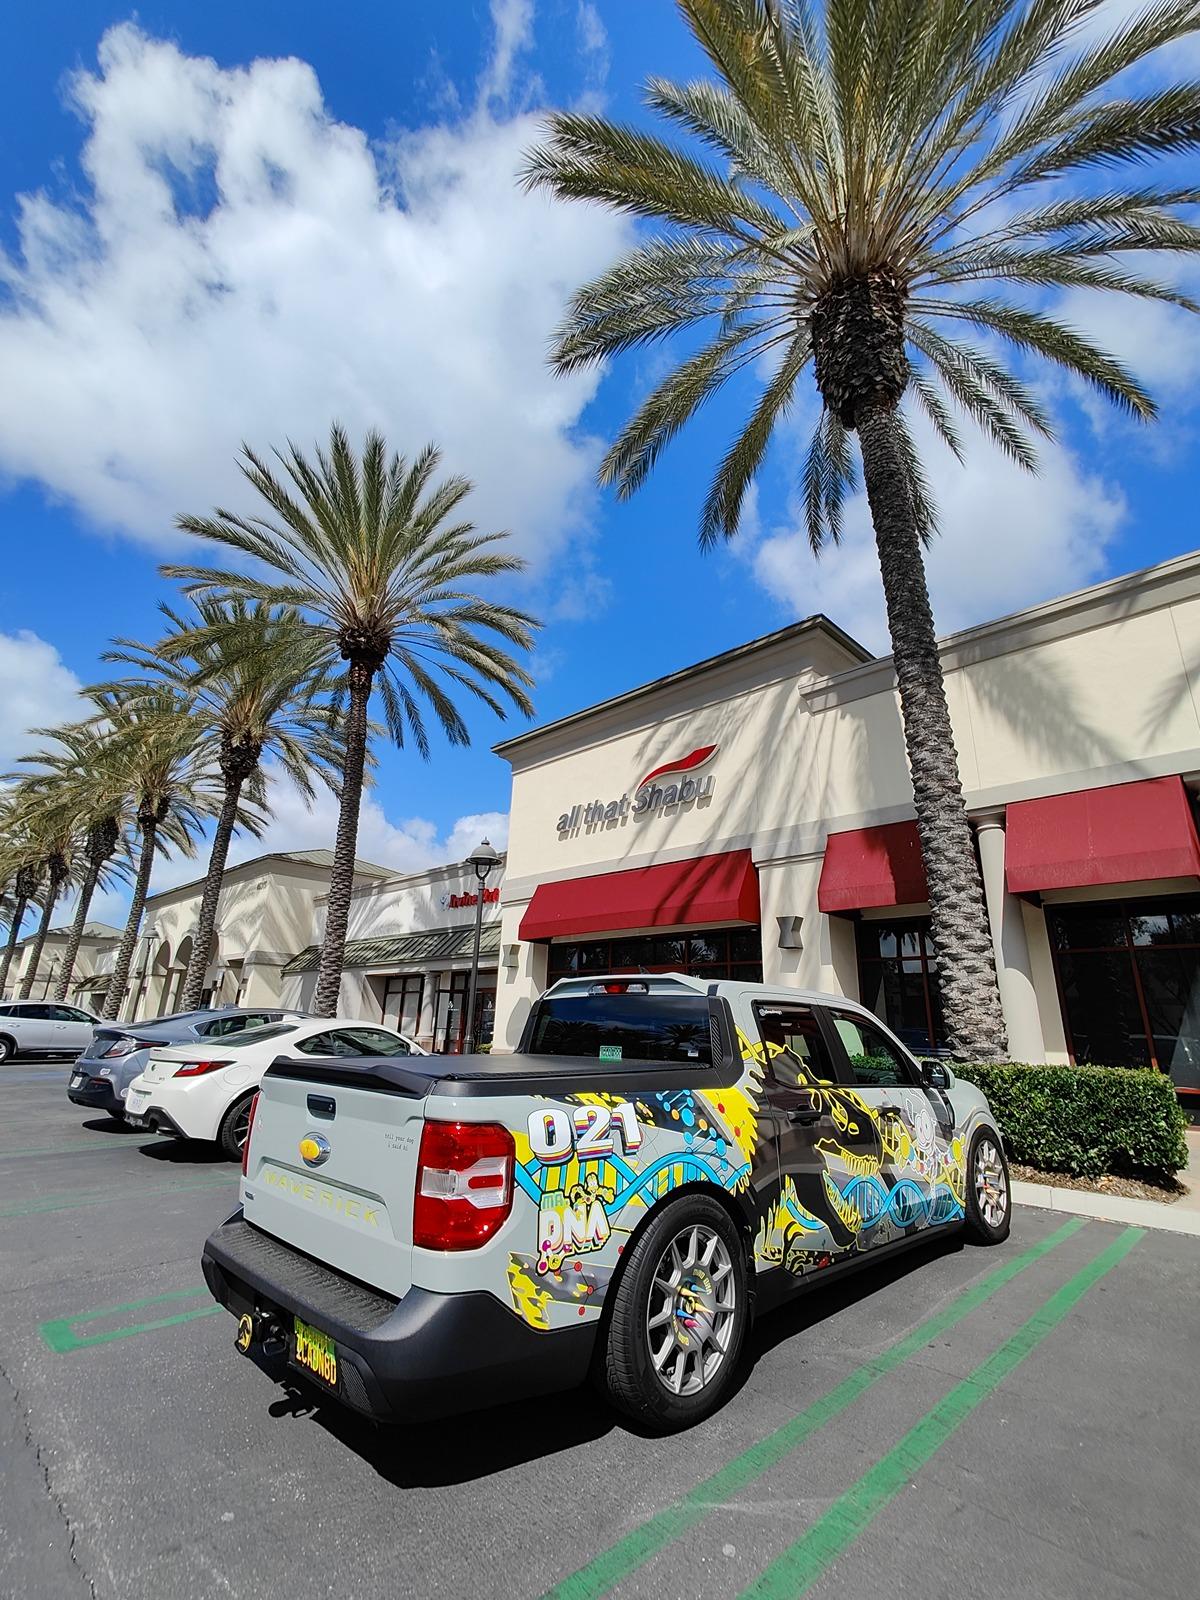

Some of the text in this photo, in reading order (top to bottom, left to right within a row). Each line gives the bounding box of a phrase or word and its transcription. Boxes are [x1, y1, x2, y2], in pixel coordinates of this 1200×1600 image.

[556, 774, 716, 832] all that Shabu
[527, 1102, 642, 1165] 021
[263, 1168, 381, 1227] MAVERICK
[539, 1200, 611, 1251] DNA
